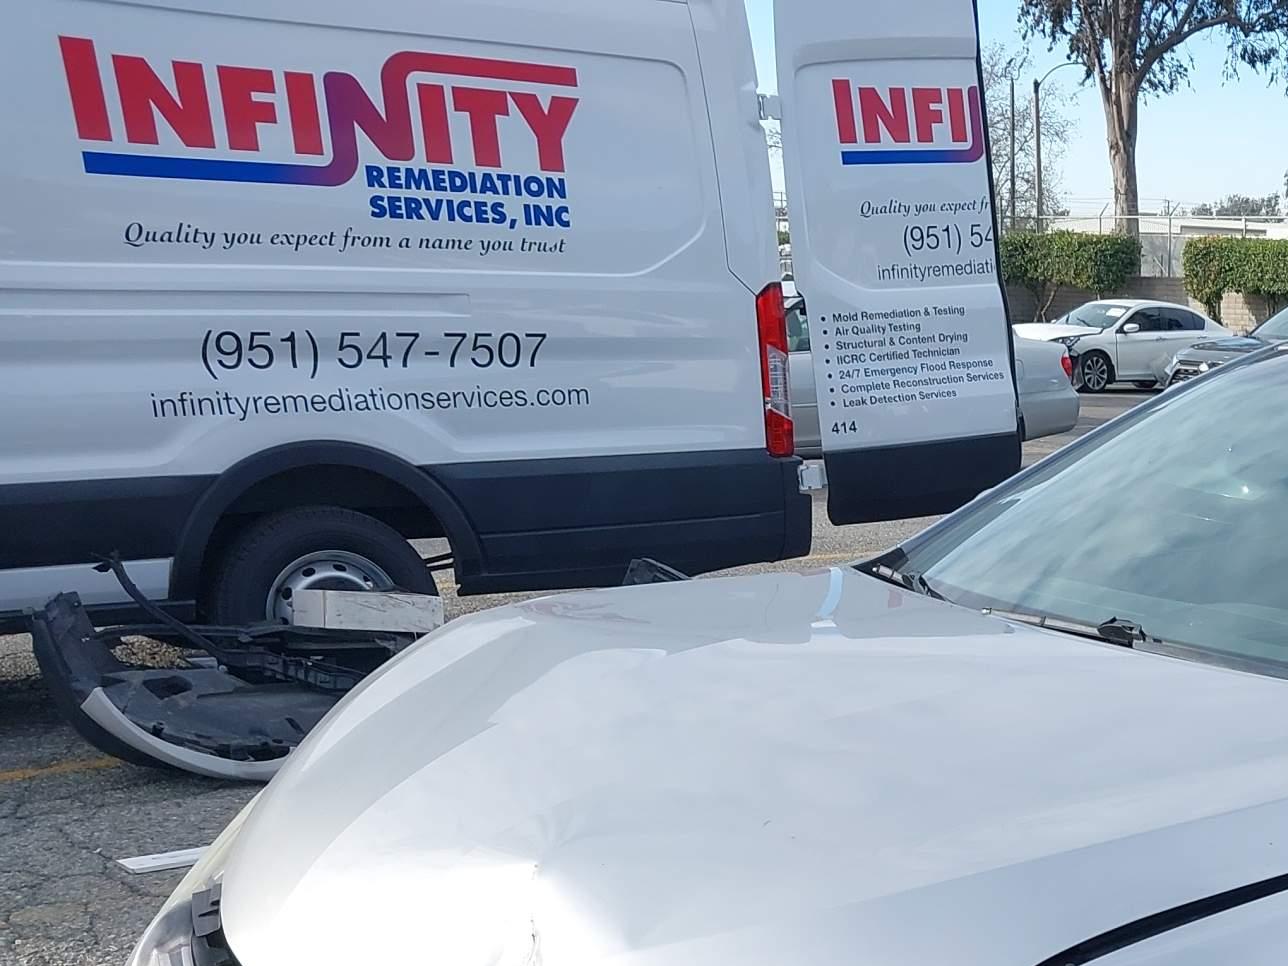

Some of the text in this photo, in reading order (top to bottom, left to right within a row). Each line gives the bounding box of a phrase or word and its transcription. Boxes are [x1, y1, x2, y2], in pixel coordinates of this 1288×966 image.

[58, 35, 579, 186] INFINITY
[365, 166, 567, 199] REMEDIATION
[369, 194, 571, 230] SERVICES, INC
[860, 199, 910, 218] Quality
[914, 202, 936, 216] you
[940, 199, 977, 215] expect
[123, 222, 567, 256] Quality you expect from a name you trust
[904, 223, 962, 257] (951)
[877, 258, 995, 282] infinityremediati
[832, 306, 965, 323] Mold Remediation & Testing
[835, 323, 921, 336] Air Quality Testing
[836, 332, 968, 350] Structural & Content Drying
[200, 329, 548, 379] (951) 547-7507
[836, 347, 961, 365] IICRC Certified Technician
[839, 359, 994, 380] 24/7 Emergency Flood Response
[841, 371, 1005, 394] Complete Reconstruction Services
[150, 384, 591, 422] infinityremediationservices.com
[843, 389, 957, 408] Leak Detection Services
[831, 421, 858, 435] 414
